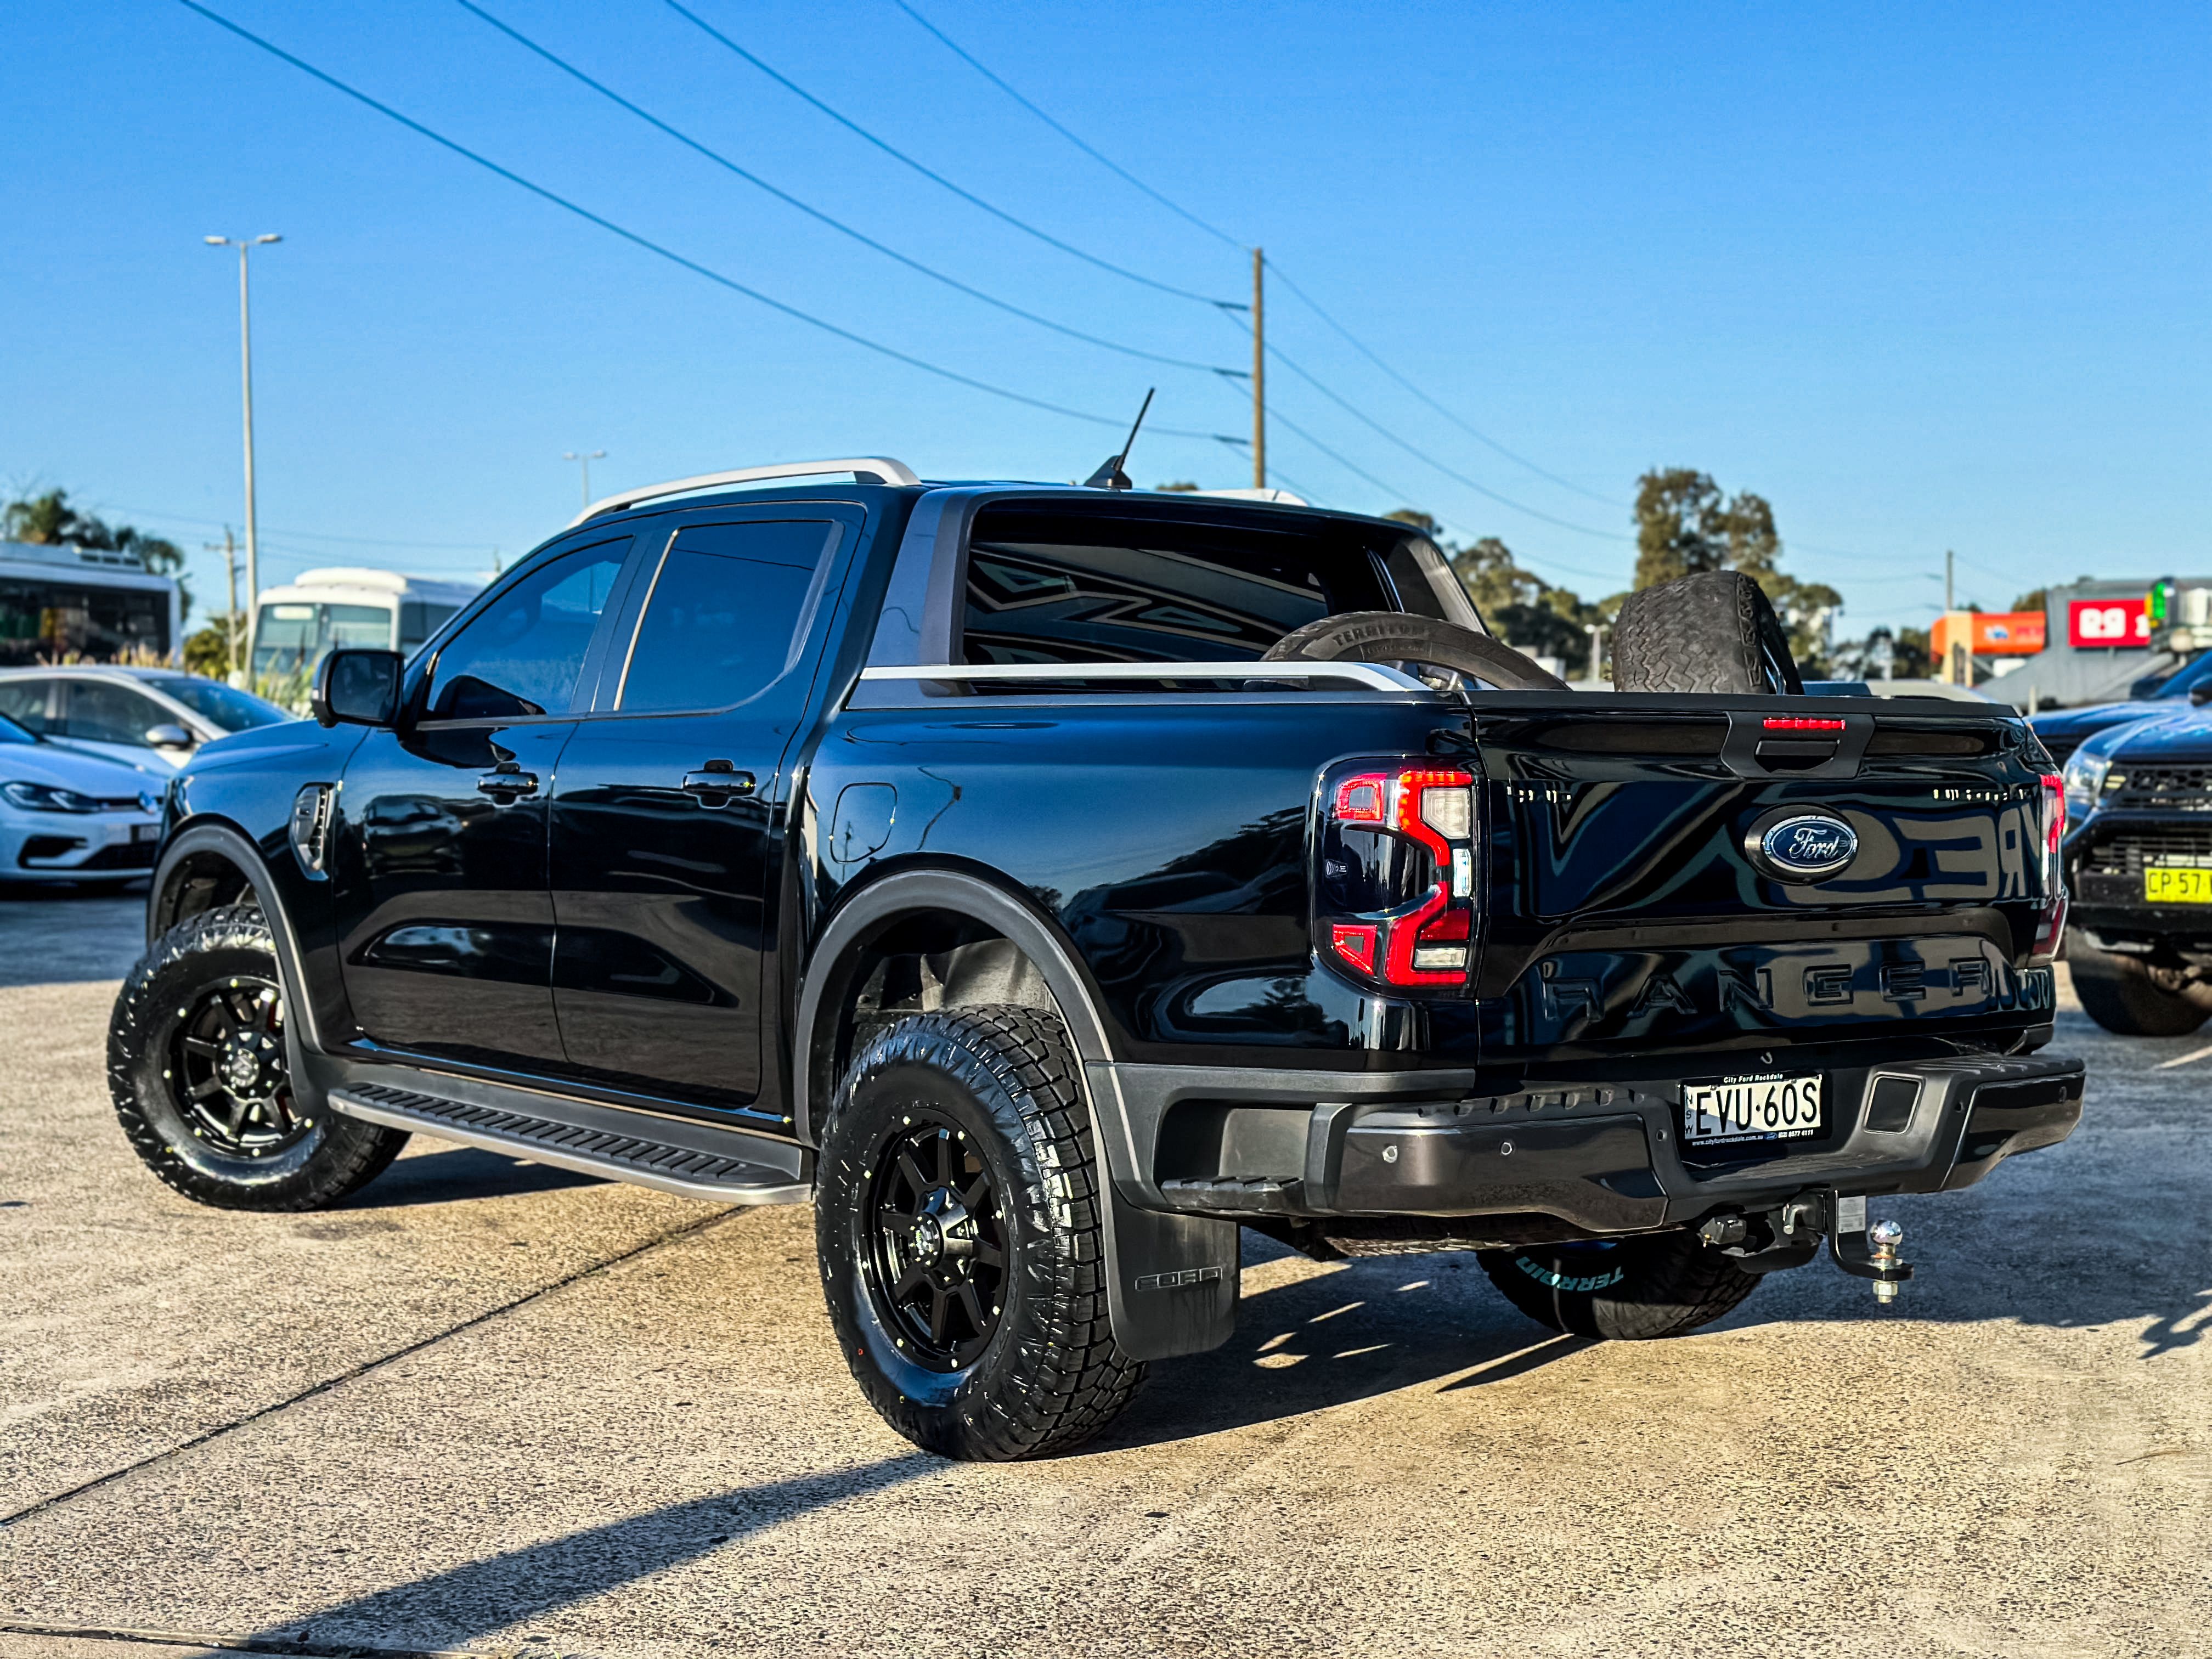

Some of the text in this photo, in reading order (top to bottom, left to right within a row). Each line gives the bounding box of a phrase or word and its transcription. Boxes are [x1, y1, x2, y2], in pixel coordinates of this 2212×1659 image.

[1789, 828, 1839, 859] Ford
[1542, 958, 1993, 1022] RANGER
[1135, 1266, 1223, 1290] FORD
[1516, 1256, 1624, 1291] TERRAIN
